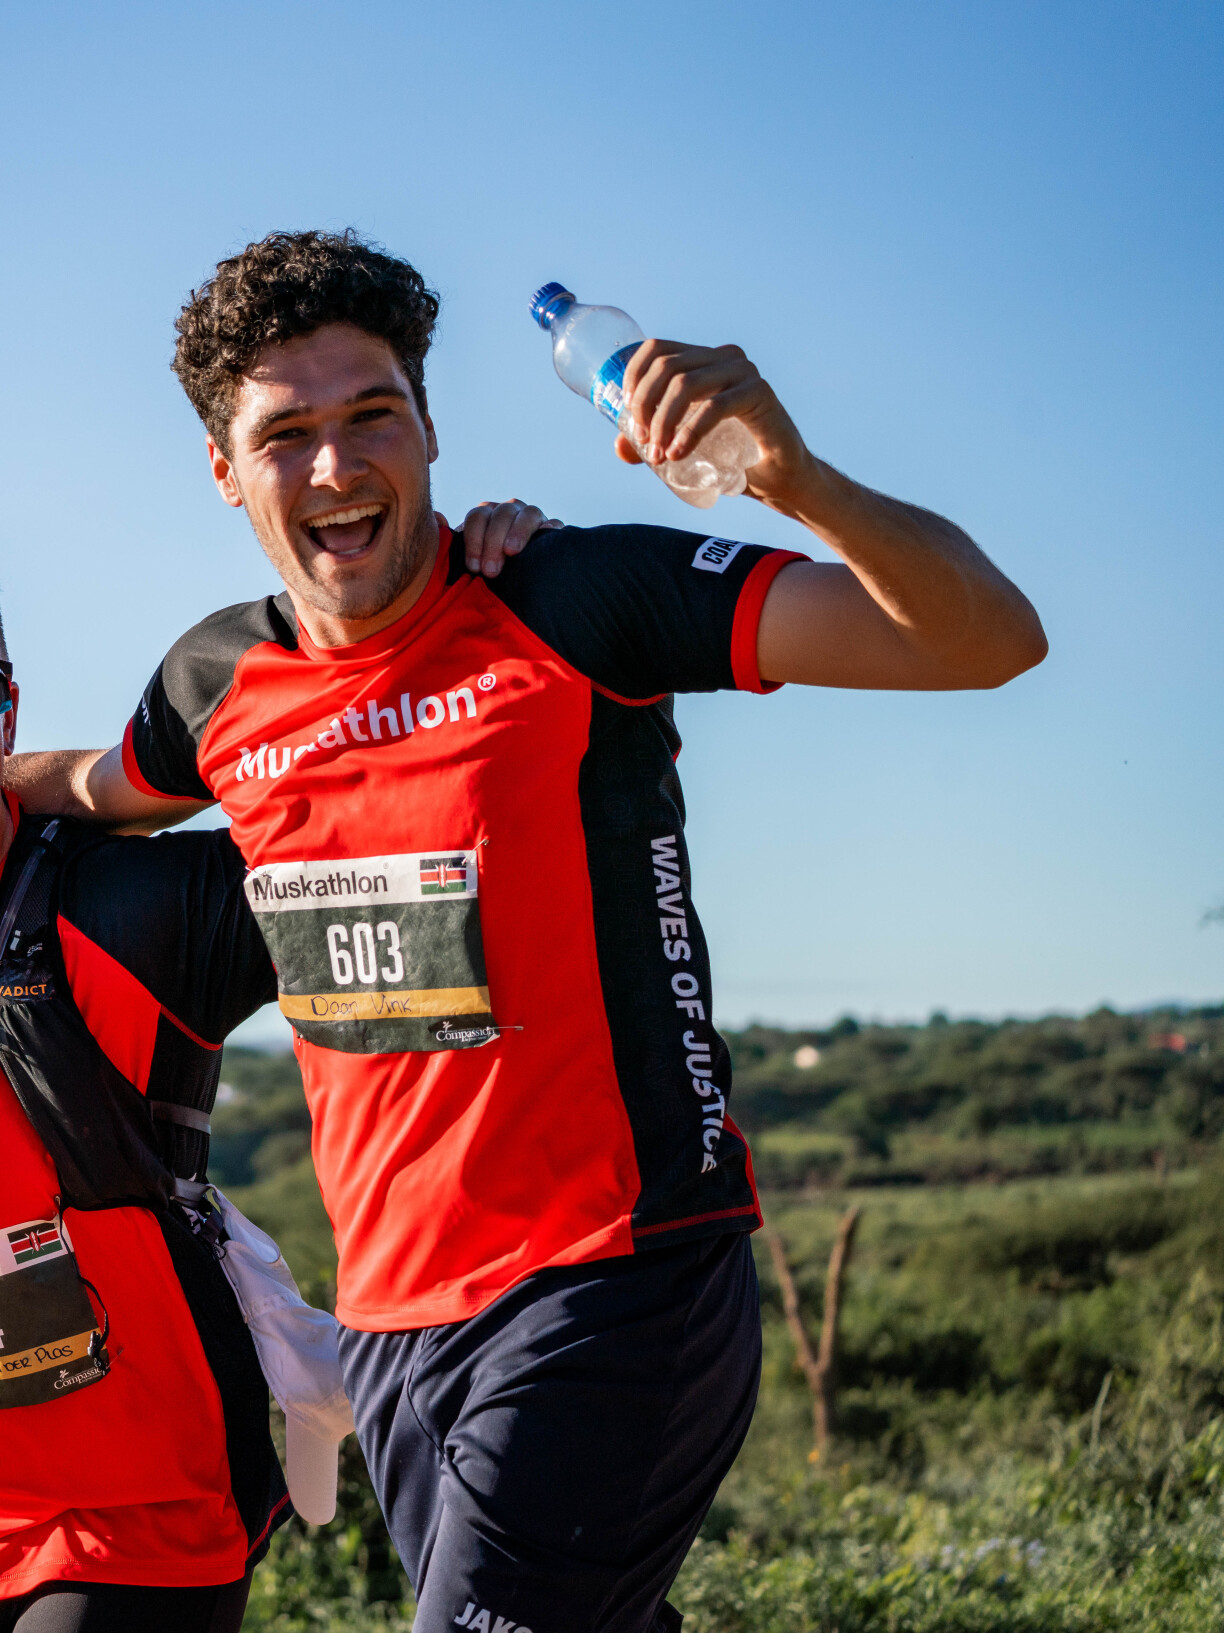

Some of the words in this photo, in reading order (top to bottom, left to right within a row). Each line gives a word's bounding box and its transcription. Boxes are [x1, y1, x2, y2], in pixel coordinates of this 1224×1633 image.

[252, 871, 388, 901] Muskathlon
[650, 834, 691, 962] WAVES
[671, 972, 706, 1022] OF
[326, 920, 406, 985] 603
[370, 994, 412, 1015] Vink
